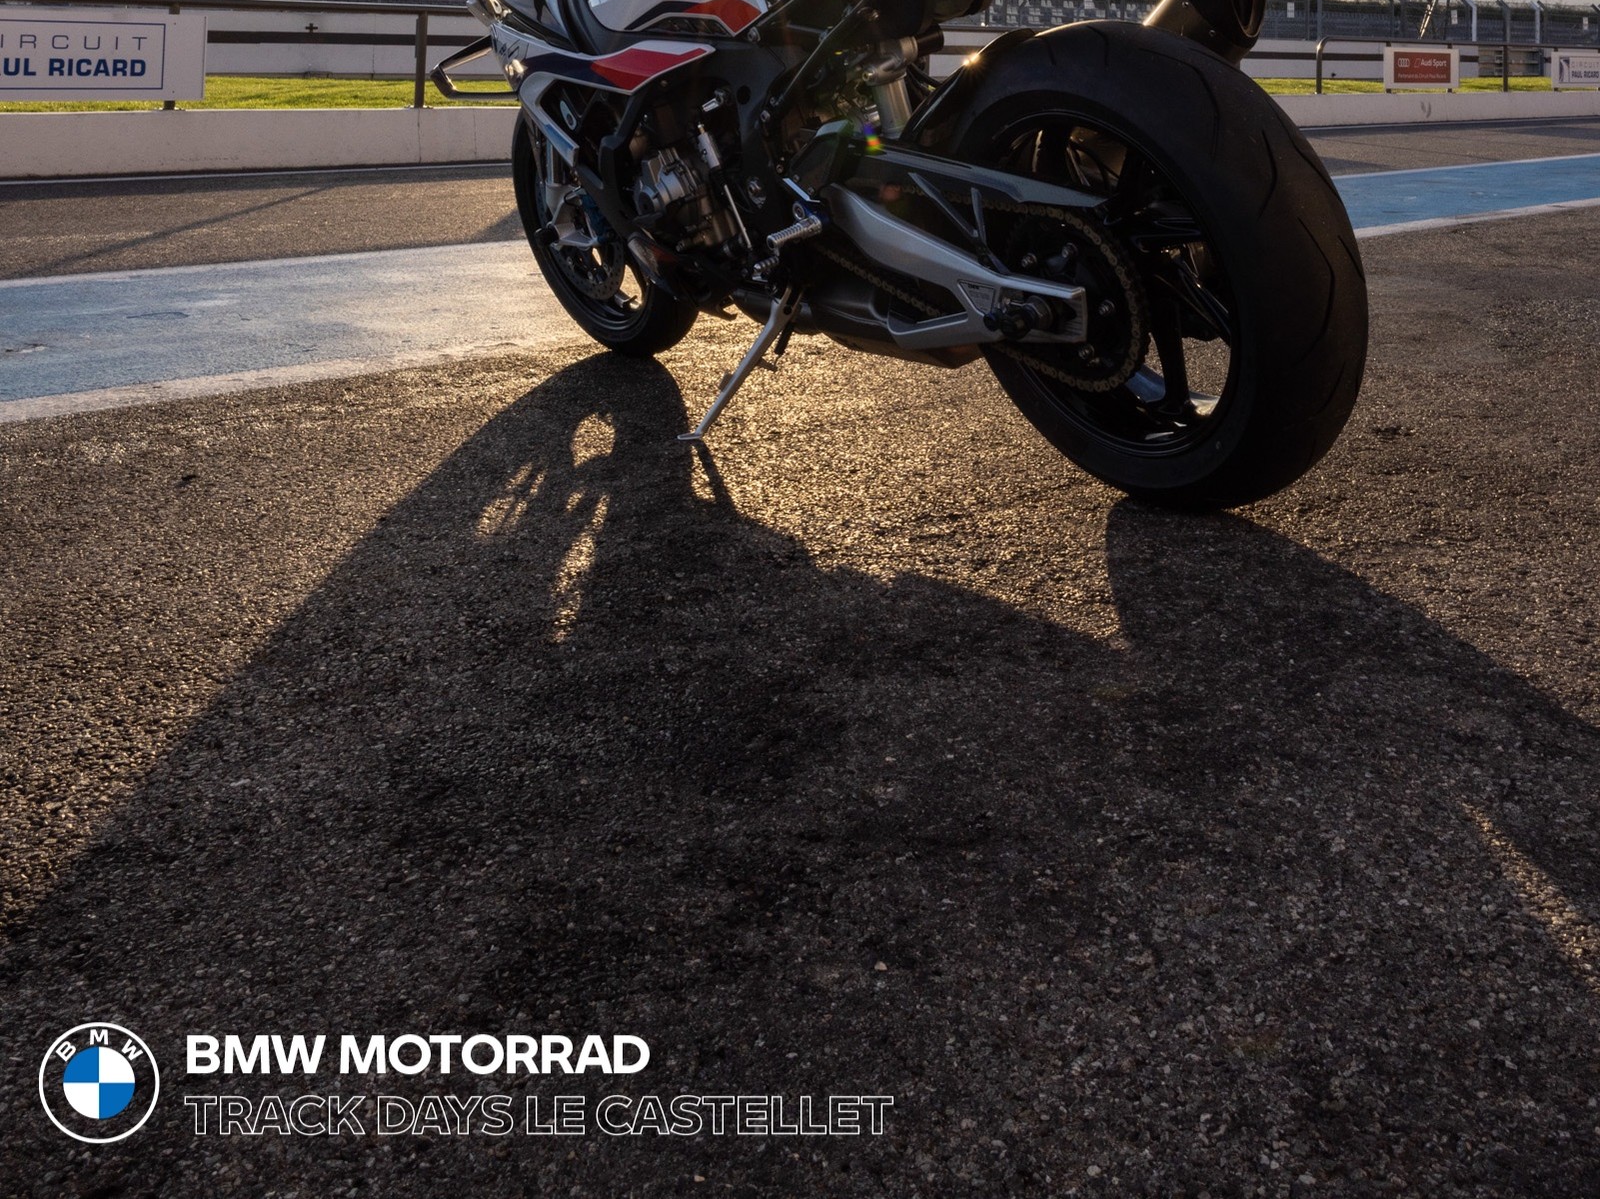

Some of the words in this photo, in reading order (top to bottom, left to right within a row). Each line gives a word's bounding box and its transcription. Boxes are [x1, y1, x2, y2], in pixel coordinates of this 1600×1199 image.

[0, 58, 37, 76] UL
[48, 58, 146, 77] RICARD
[1421, 58, 1432, 67] Audi
[1433, 59, 1447, 69] Sport
